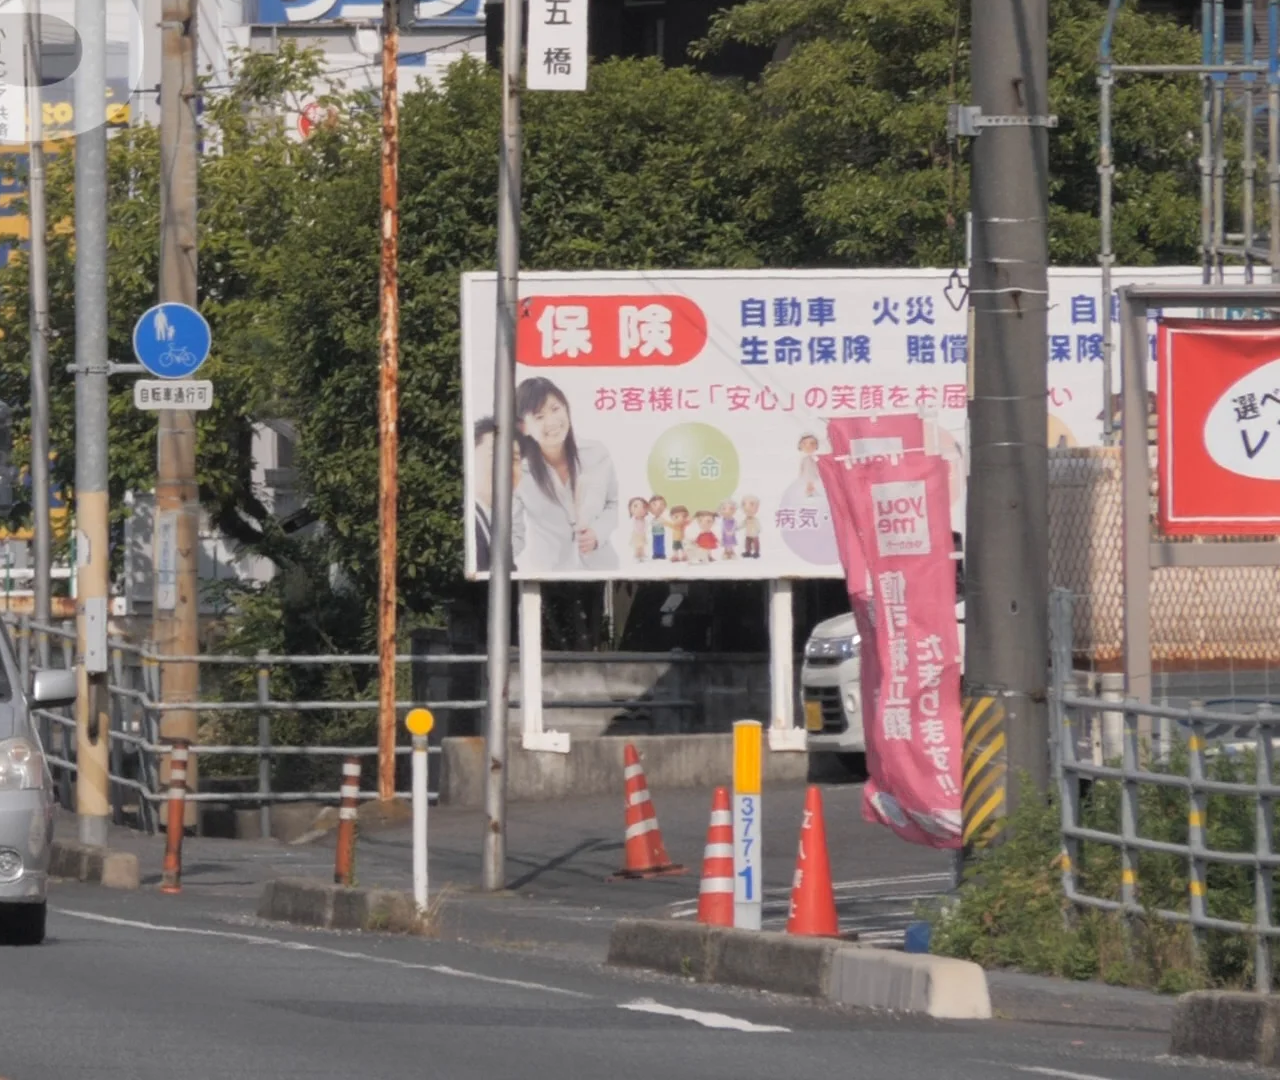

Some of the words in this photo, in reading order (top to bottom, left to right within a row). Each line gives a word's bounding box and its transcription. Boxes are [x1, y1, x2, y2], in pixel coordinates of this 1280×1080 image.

[740, 297, 837, 328] 自動車
[872, 296, 936, 325] 火災
[536, 304, 674, 359] 保険
[740, 334, 872, 366] 生命保険
[139, 387, 208, 404] 自転車通行可
[666, 456, 721, 479] 生命
